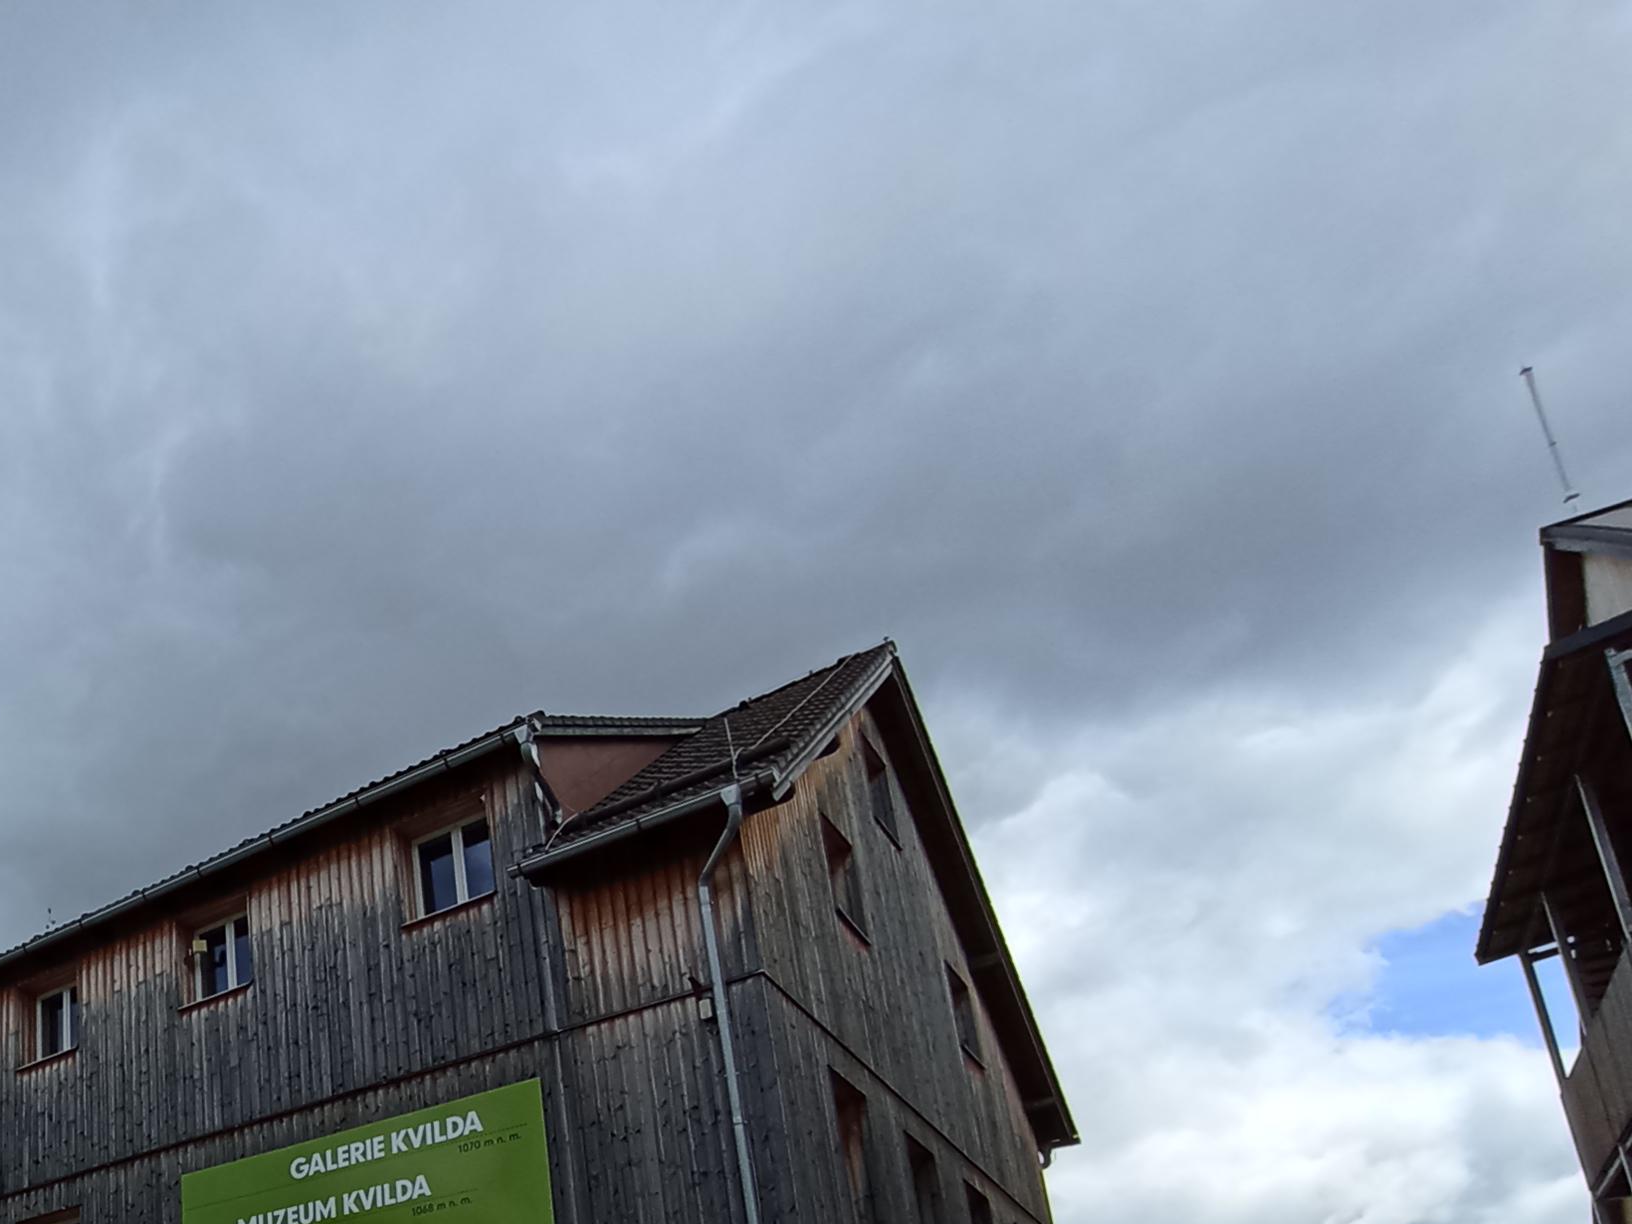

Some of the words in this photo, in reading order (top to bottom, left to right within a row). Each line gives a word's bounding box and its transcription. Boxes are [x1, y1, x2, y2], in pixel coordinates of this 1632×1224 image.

[290, 1135, 385, 1180] GALERIE
[391, 1110, 483, 1155] KVILDA
[458, 1139, 481, 1153] 1070
[342, 1174, 432, 1215] KVILDA
